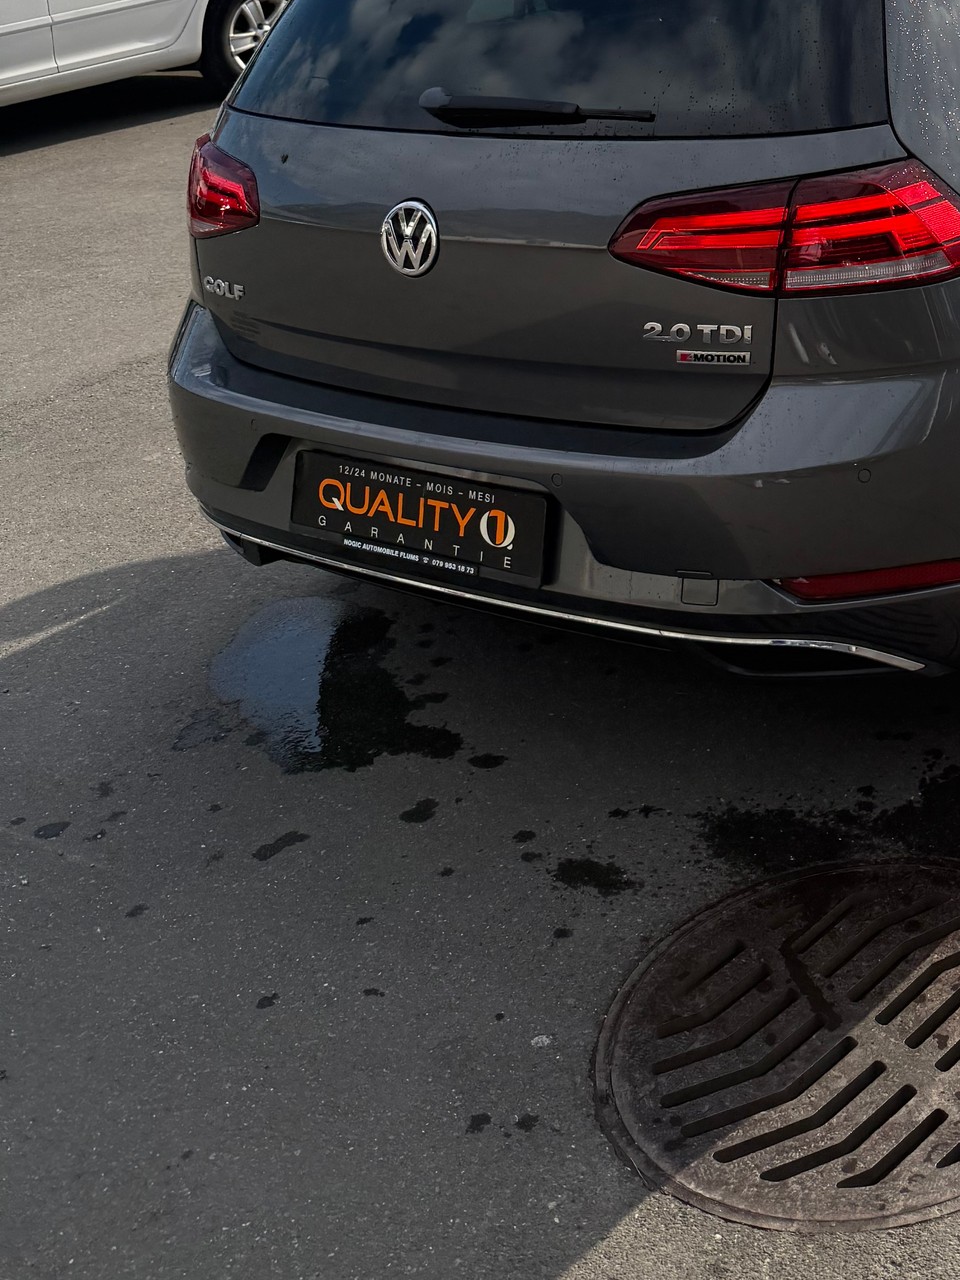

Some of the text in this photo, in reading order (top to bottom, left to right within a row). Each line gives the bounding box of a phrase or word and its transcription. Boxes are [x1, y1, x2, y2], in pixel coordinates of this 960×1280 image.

[203, 275, 245, 300] GOLF
[643, 322, 752, 344] 2.0 TDI
[684, 353, 746, 363] 4MOTION
[339, 465, 365, 478] 12/24
[370, 470, 412, 487] MONATE
[426, 481, 453, 495] MOIS
[468, 490, 495, 504] MESI
[318, 478, 476, 537] QUALITY
[318, 515, 511, 569] GARANTIE
[362, 543, 399, 557] AUTOMOBILE
[400, 551, 419, 562] FLUMS
